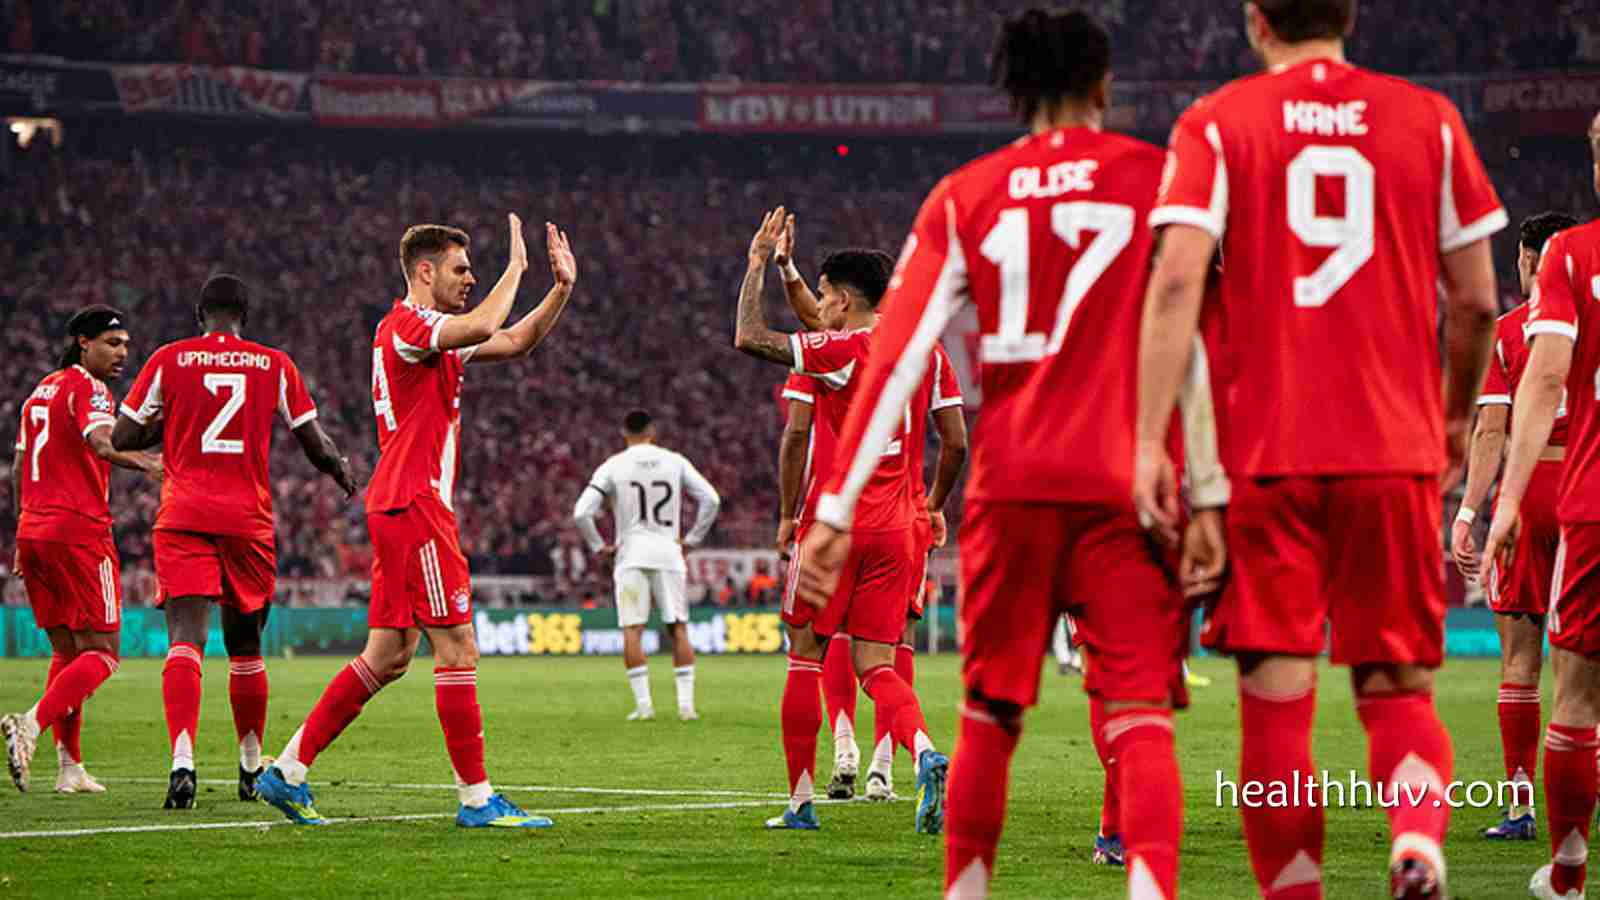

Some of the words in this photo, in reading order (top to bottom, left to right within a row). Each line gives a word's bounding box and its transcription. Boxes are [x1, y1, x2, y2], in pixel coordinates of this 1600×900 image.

[1283, 100, 1368, 136] KANE
[1008, 159, 1099, 199] OLISE
[1286, 145, 1375, 307] 9
[979, 201, 1136, 363] 17
[177, 351, 271, 370] UPAMECANO
[201, 373, 247, 454] 2
[30, 405, 49, 482] 7
[630, 481, 673, 527] 12
[476, 611, 582, 655] bet365
